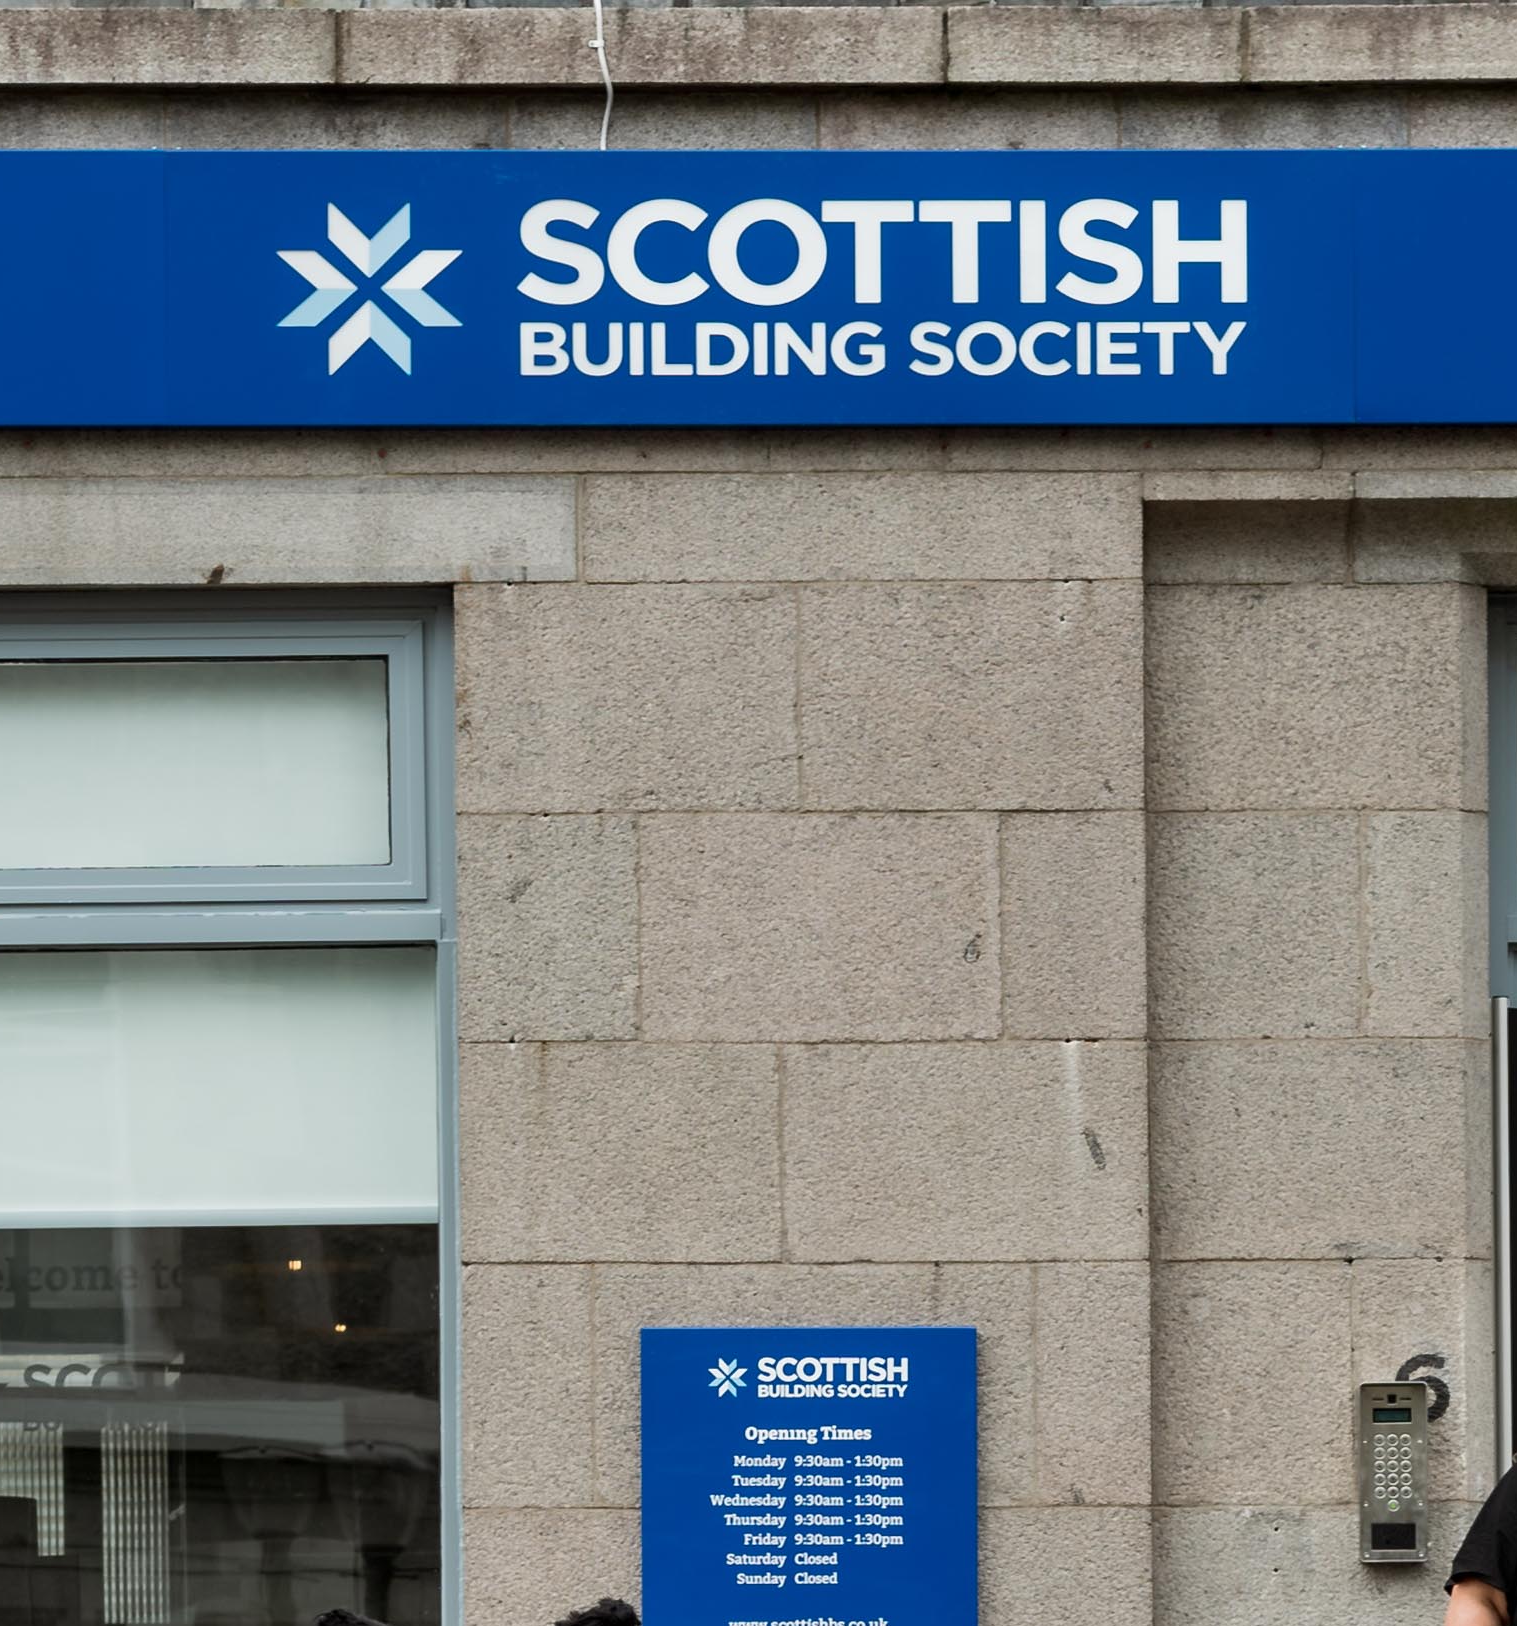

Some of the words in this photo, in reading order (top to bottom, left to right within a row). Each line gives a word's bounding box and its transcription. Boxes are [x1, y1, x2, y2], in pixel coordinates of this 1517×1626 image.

[518, 199, 1247, 305] SCOTTISH
[520, 321, 886, 377] BUILDING
[909, 321, 1247, 376] SOCIETY
[757, 1356, 909, 1382] SCOTTISH
[757, 1383, 835, 1399] BUILDING
[836, 1383, 908, 1399] SOCIETY
[744, 1425, 818, 1445] Opening
[820, 1425, 872, 1441] Times
[733, 1454, 787, 1470] Monday
[793, 1454, 845, 1467] 9:30am
[854, 1454, 904, 1469] 1:30pm
[731, 1474, 787, 1490] Tuesday
[793, 1474, 845, 1487] 9:30am
[854, 1474, 904, 1489] 1:30pm
[709, 1493, 787, 1509] Wednesday
[793, 1494, 845, 1507] 9:30am
[854, 1494, 904, 1509] 1:30pm
[723, 1513, 787, 1529] Thursday
[793, 1513, 845, 1526] 9:30am
[854, 1513, 904, 1528] 1:30pm
[743, 1532, 787, 1548] Friday
[793, 1533, 845, 1546] 9:30am
[854, 1533, 904, 1548] 1:30pm
[726, 1552, 787, 1568] Saturday
[794, 1552, 839, 1565] Closed
[736, 1571, 787, 1588] Sunday
[794, 1571, 839, 1585] Closed
